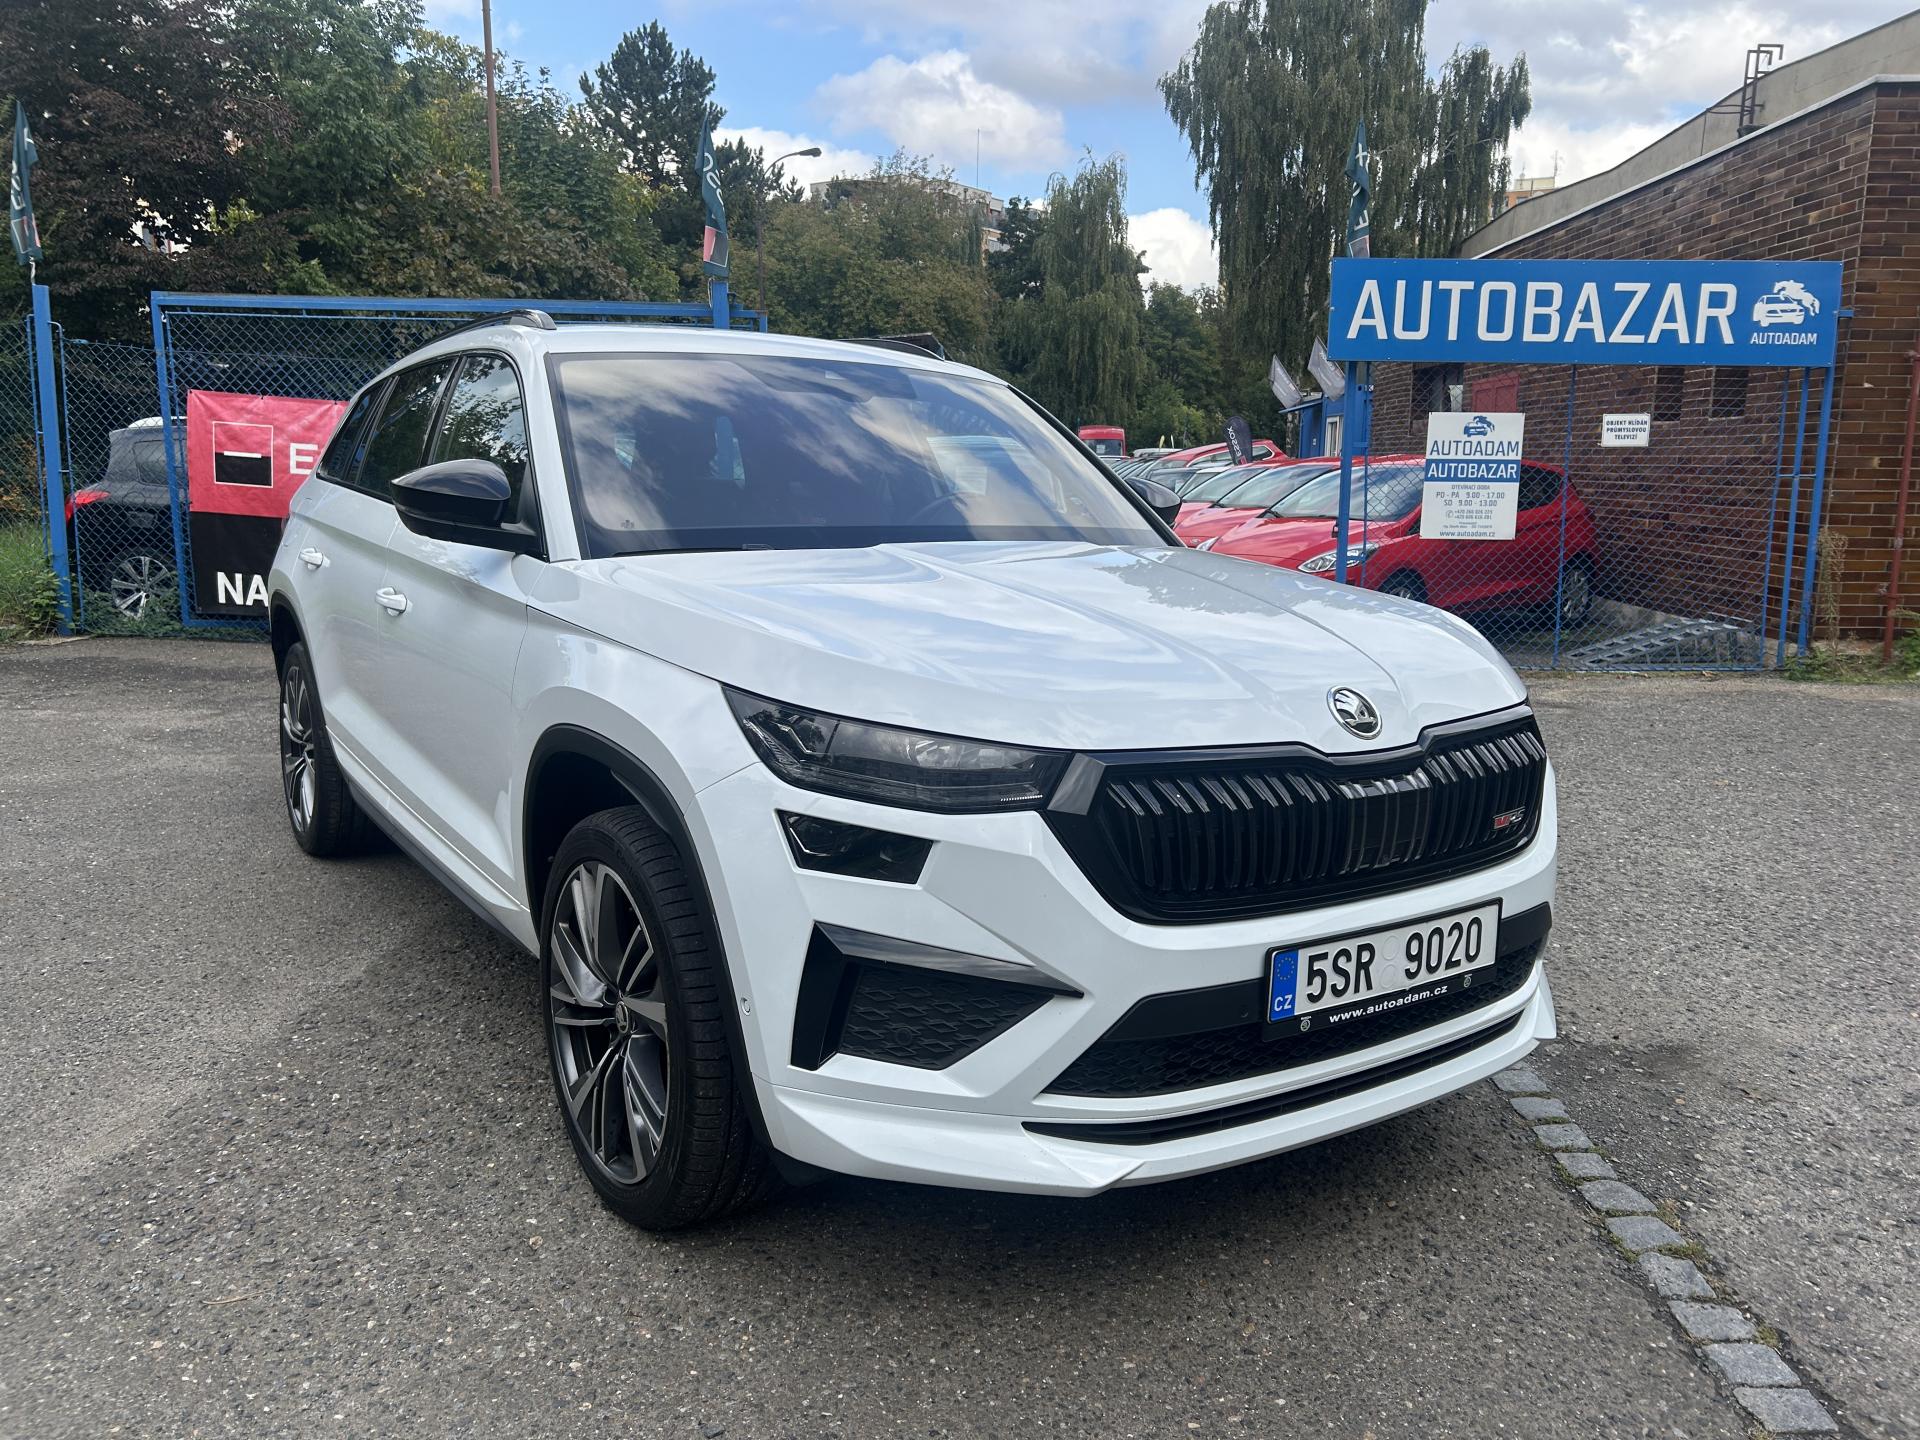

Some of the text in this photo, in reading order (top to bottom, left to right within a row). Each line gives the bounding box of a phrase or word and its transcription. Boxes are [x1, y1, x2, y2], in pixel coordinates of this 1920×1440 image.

[1346, 279, 1737, 345] AUTOBAZAR
[1750, 332, 1818, 345] AUTOADAM
[1430, 440, 1520, 457] AUTOADAM
[1428, 463, 1517, 479] AUTOBAZAR
[1436, 491, 1445, 499] PO
[1306, 916, 1483, 1004] 5SR 9020
[1274, 993, 1292, 1012] CZ
[1329, 984, 1448, 1023] www.autoadam.cz
